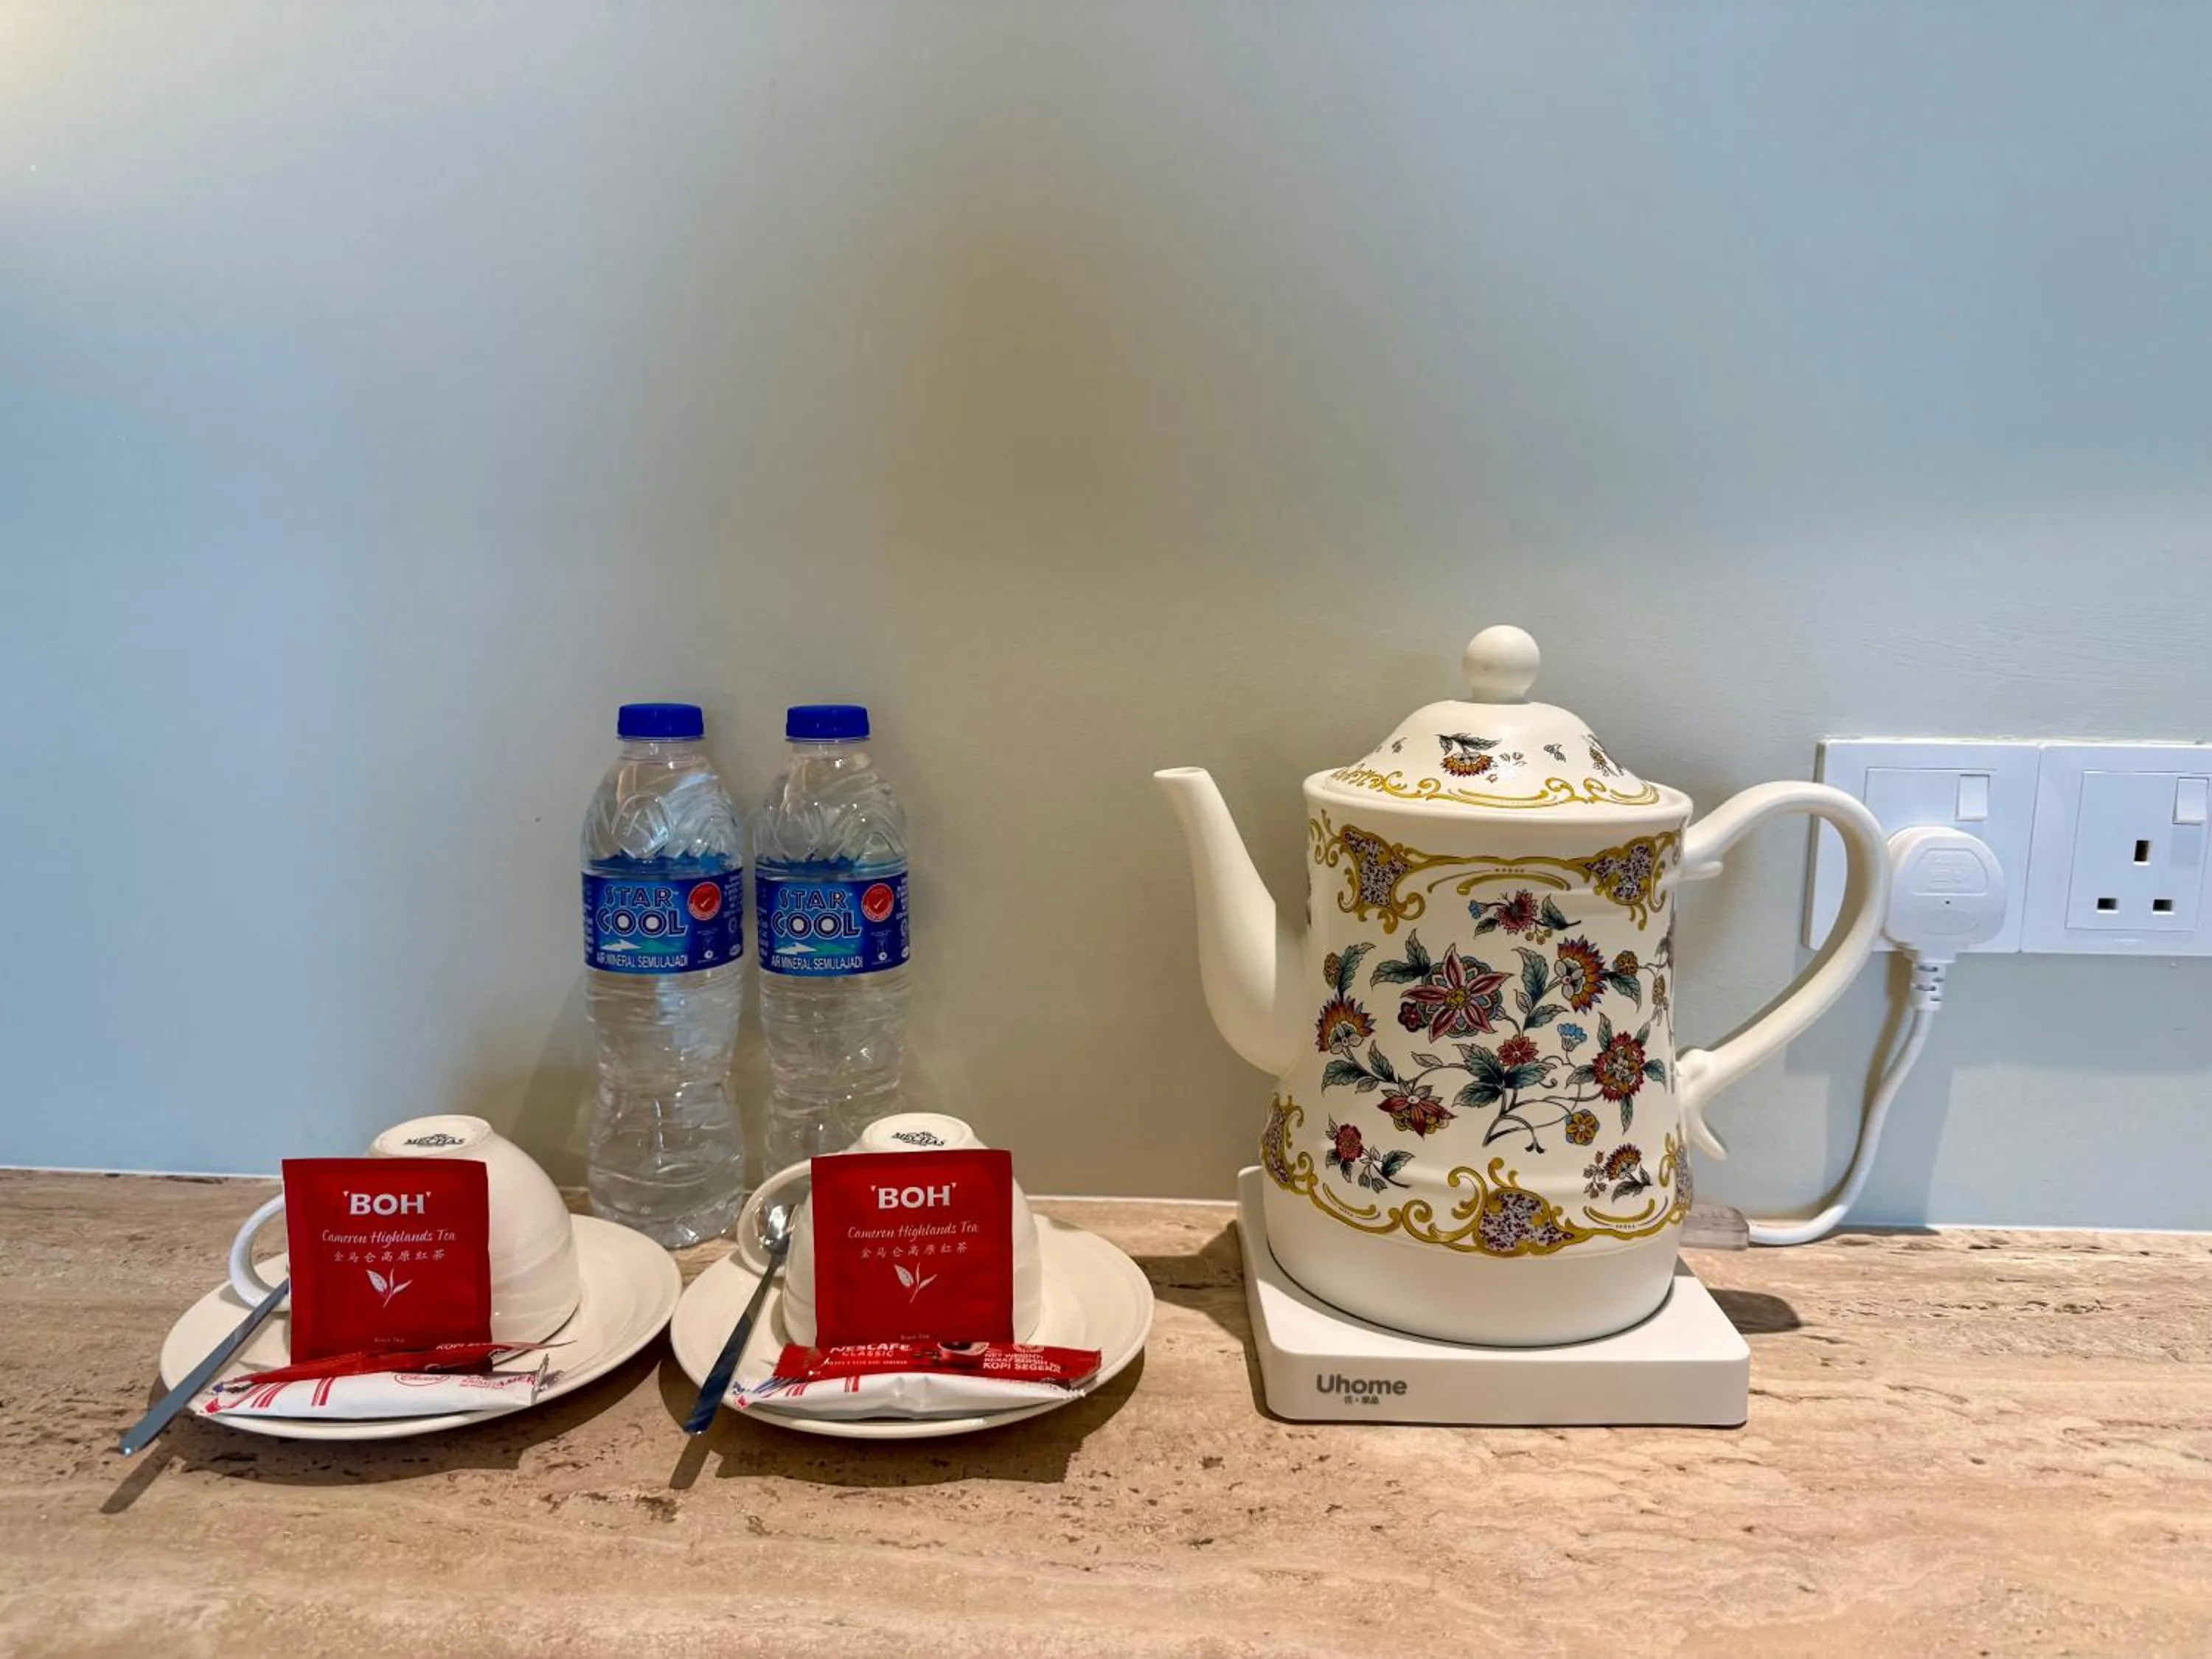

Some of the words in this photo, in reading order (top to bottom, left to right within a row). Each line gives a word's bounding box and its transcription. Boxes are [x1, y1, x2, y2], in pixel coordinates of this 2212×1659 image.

[605, 885, 675, 908] STAR
[779, 888, 849, 911] STAR
[596, 906, 689, 938] COOL
[771, 910, 863, 940] COOL
[813, 956, 863, 970] SEMULAJADI
[322, 1229, 367, 1244] Cameron
[370, 1230, 434, 1248] Highlands
[437, 1228, 456, 1242] Tea
[848, 1226, 895, 1240] Cameron
[896, 1222, 956, 1242] Highlands
[961, 1220, 979, 1233] Tea
[982, 1362, 1011, 1370] KOPI
[1316, 1374, 1408, 1395] Uhome
